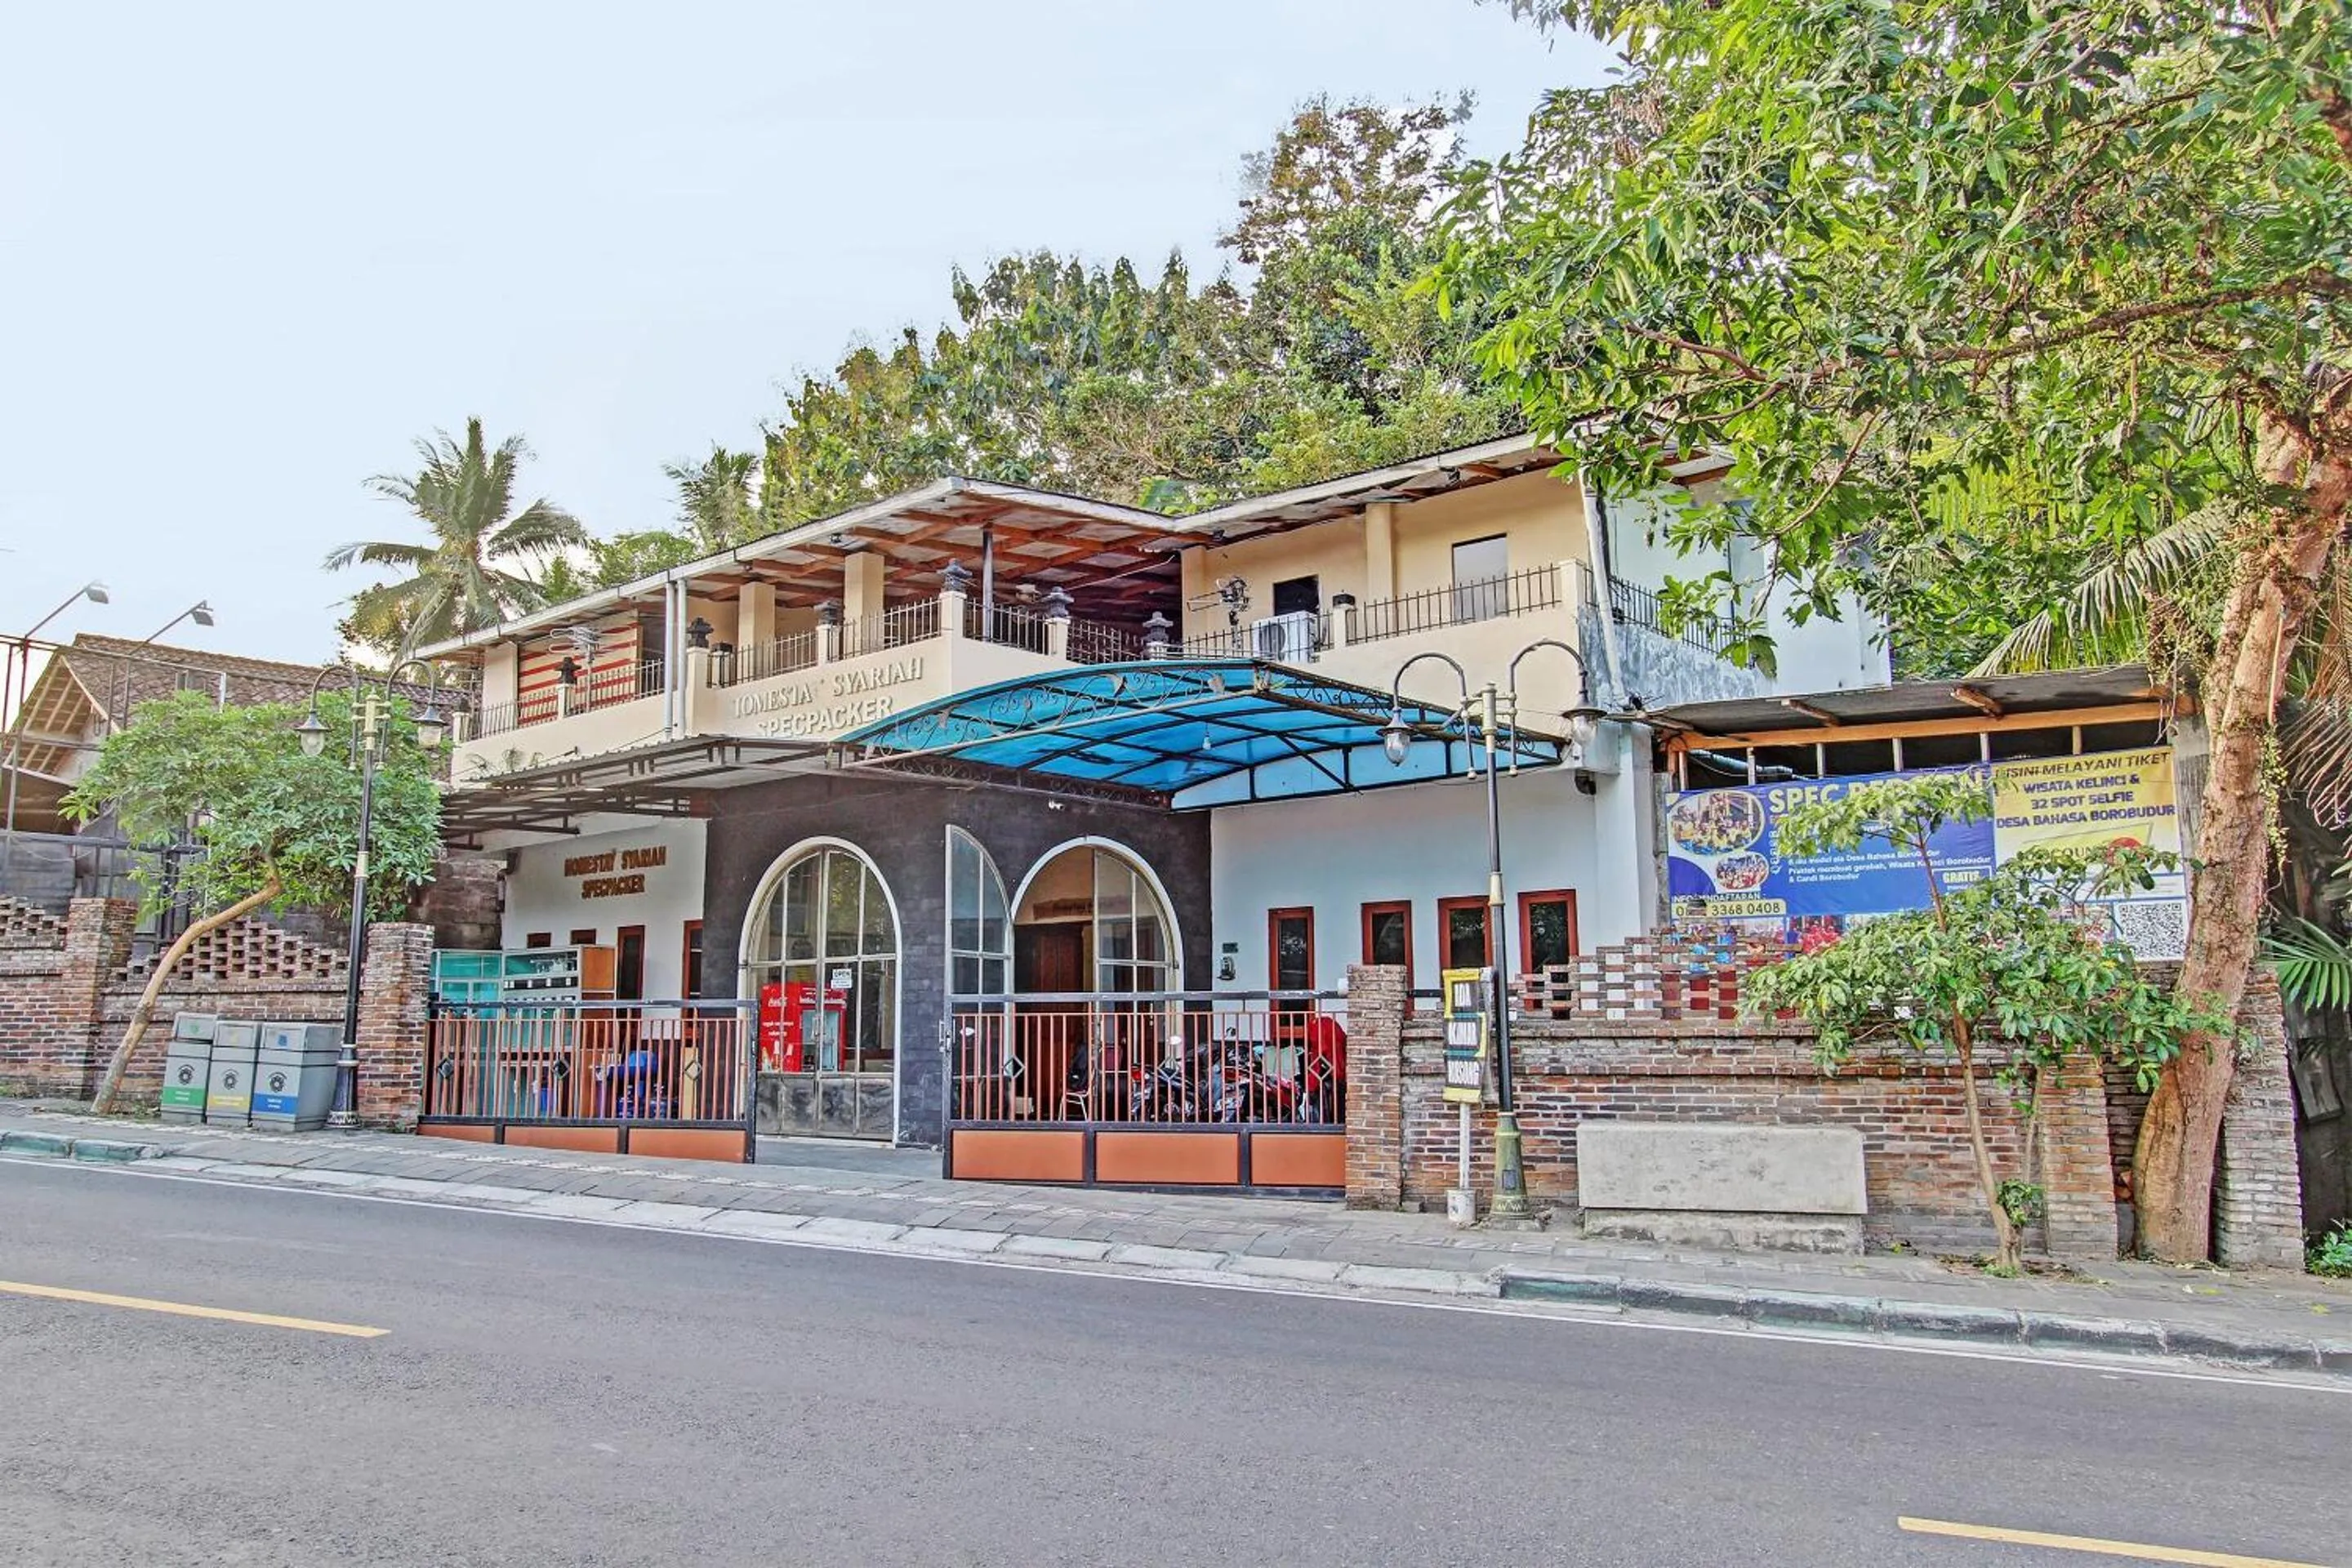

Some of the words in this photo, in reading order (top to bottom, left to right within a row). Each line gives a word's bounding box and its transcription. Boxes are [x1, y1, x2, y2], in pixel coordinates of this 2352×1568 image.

[833, 657, 924, 697] SYARIAH
[2127, 751, 2171, 767] TIKET
[2024, 781, 2072, 794] WISATA
[2076, 776, 2127, 791] KELINCI
[2129, 773, 2140, 785] &
[2031, 798, 2048, 810] 32
[2051, 794, 2085, 808] SPOT
[2088, 791, 2135, 805] SELFIE
[1996, 817, 2030, 829] DESA
[2033, 812, 2087, 826] BAHASA
[2090, 804, 2176, 822] BOROBUDUR
[1943, 871, 1980, 884] GRATIS
[1711, 904, 1743, 916] 3368
[1747, 902, 1780, 915] 0408
